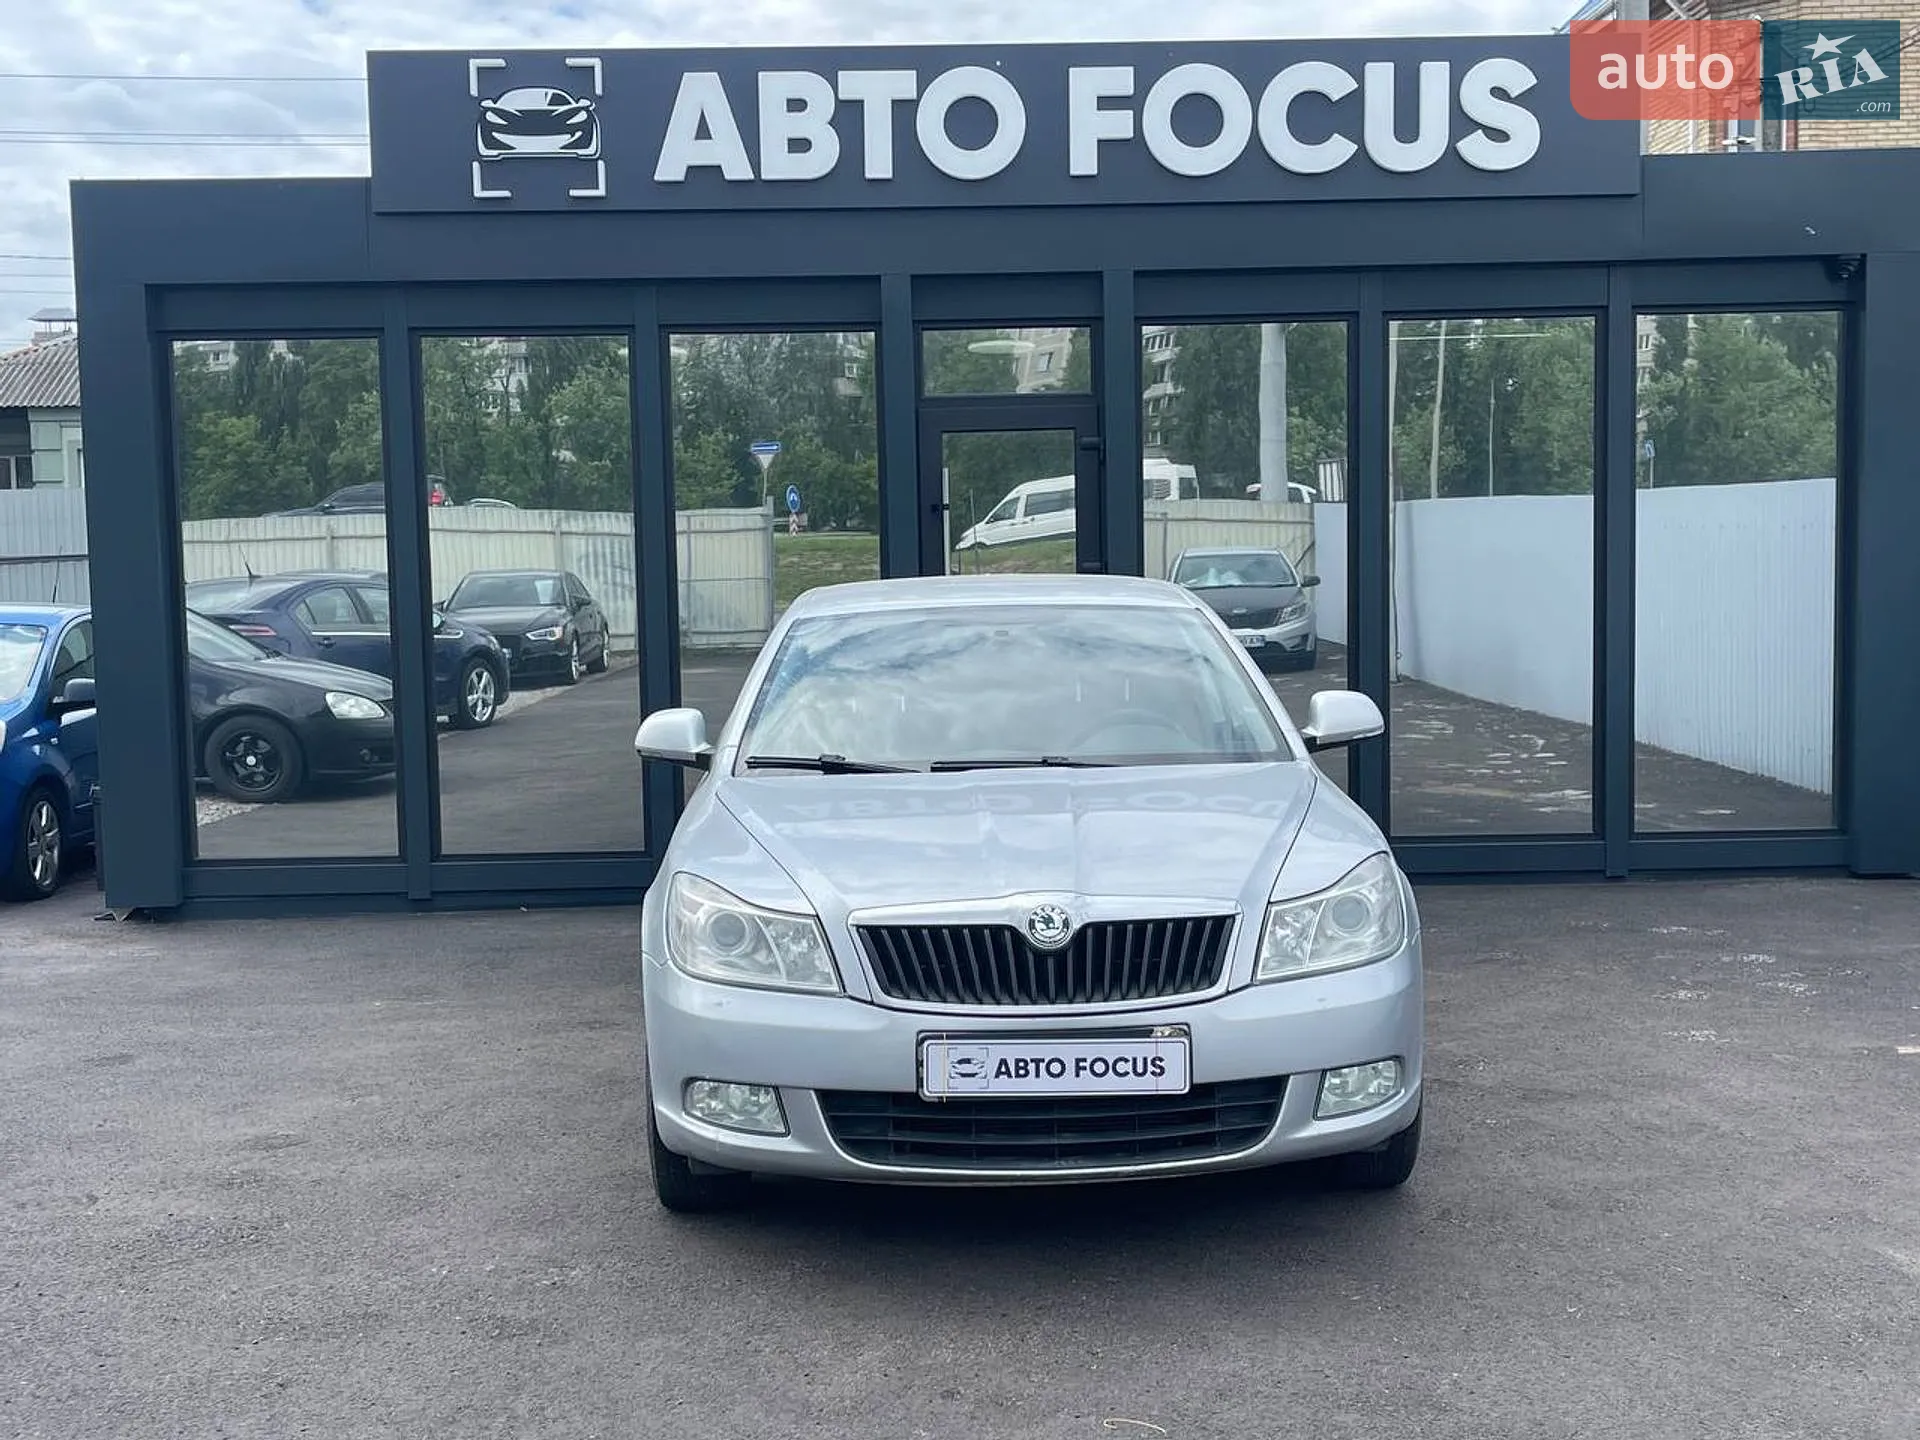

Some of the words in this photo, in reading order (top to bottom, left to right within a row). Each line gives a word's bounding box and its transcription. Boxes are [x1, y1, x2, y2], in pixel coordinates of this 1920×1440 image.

[653, 65, 1027, 183] АВТО
[1068, 57, 1542, 177] FOCUS
[994, 1057, 1067, 1080] АВТО
[1074, 1055, 1166, 1078] FOCUS
